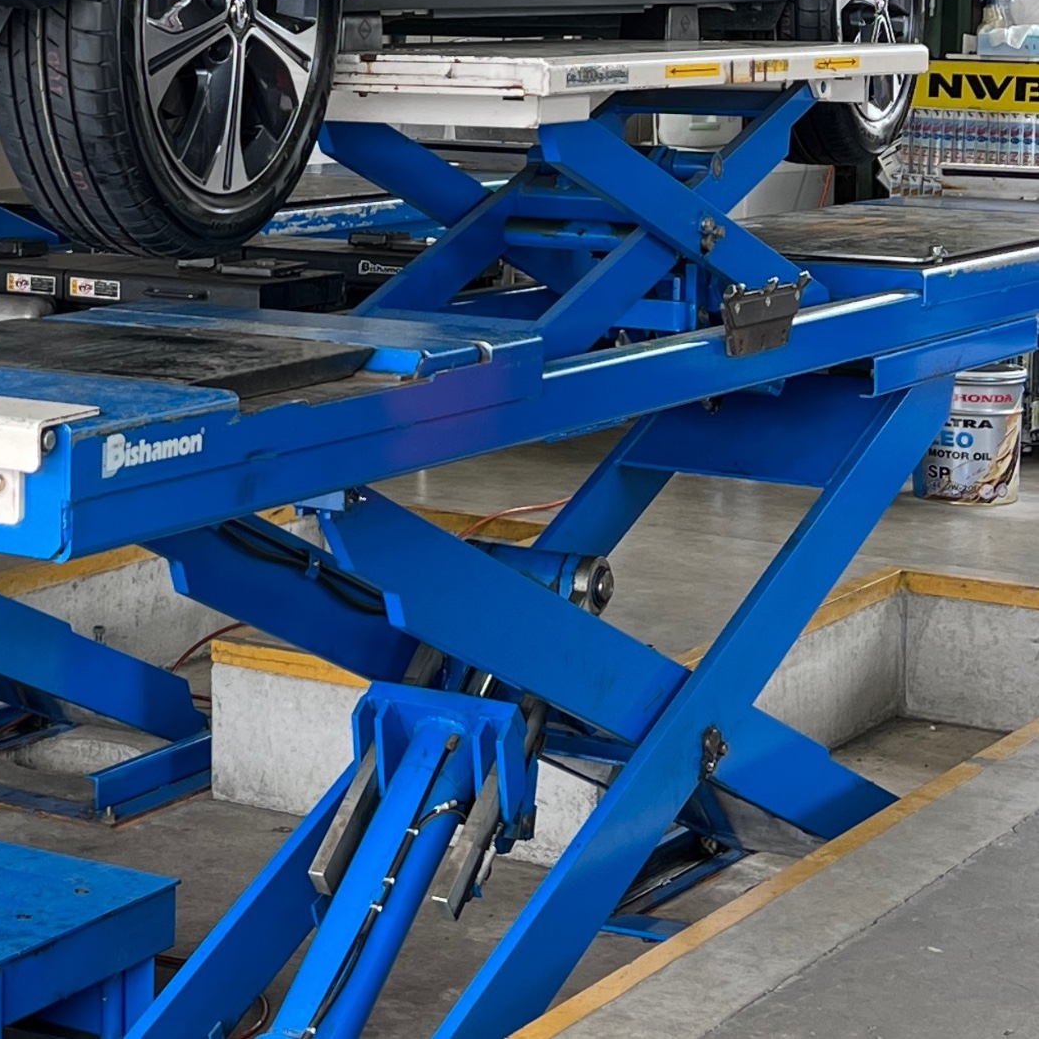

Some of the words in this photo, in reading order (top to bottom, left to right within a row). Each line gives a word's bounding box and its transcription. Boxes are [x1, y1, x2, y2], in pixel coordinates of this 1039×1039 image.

[953, 394, 1013, 403] HONDA
[944, 417, 994, 429] TRA
[932, 430, 974, 449] EO
[102, 433, 203, 479] Bishamon
[928, 448, 969, 460] MOTOR
[973, 452, 991, 461] OIL
[928, 464, 951, 479] SP
